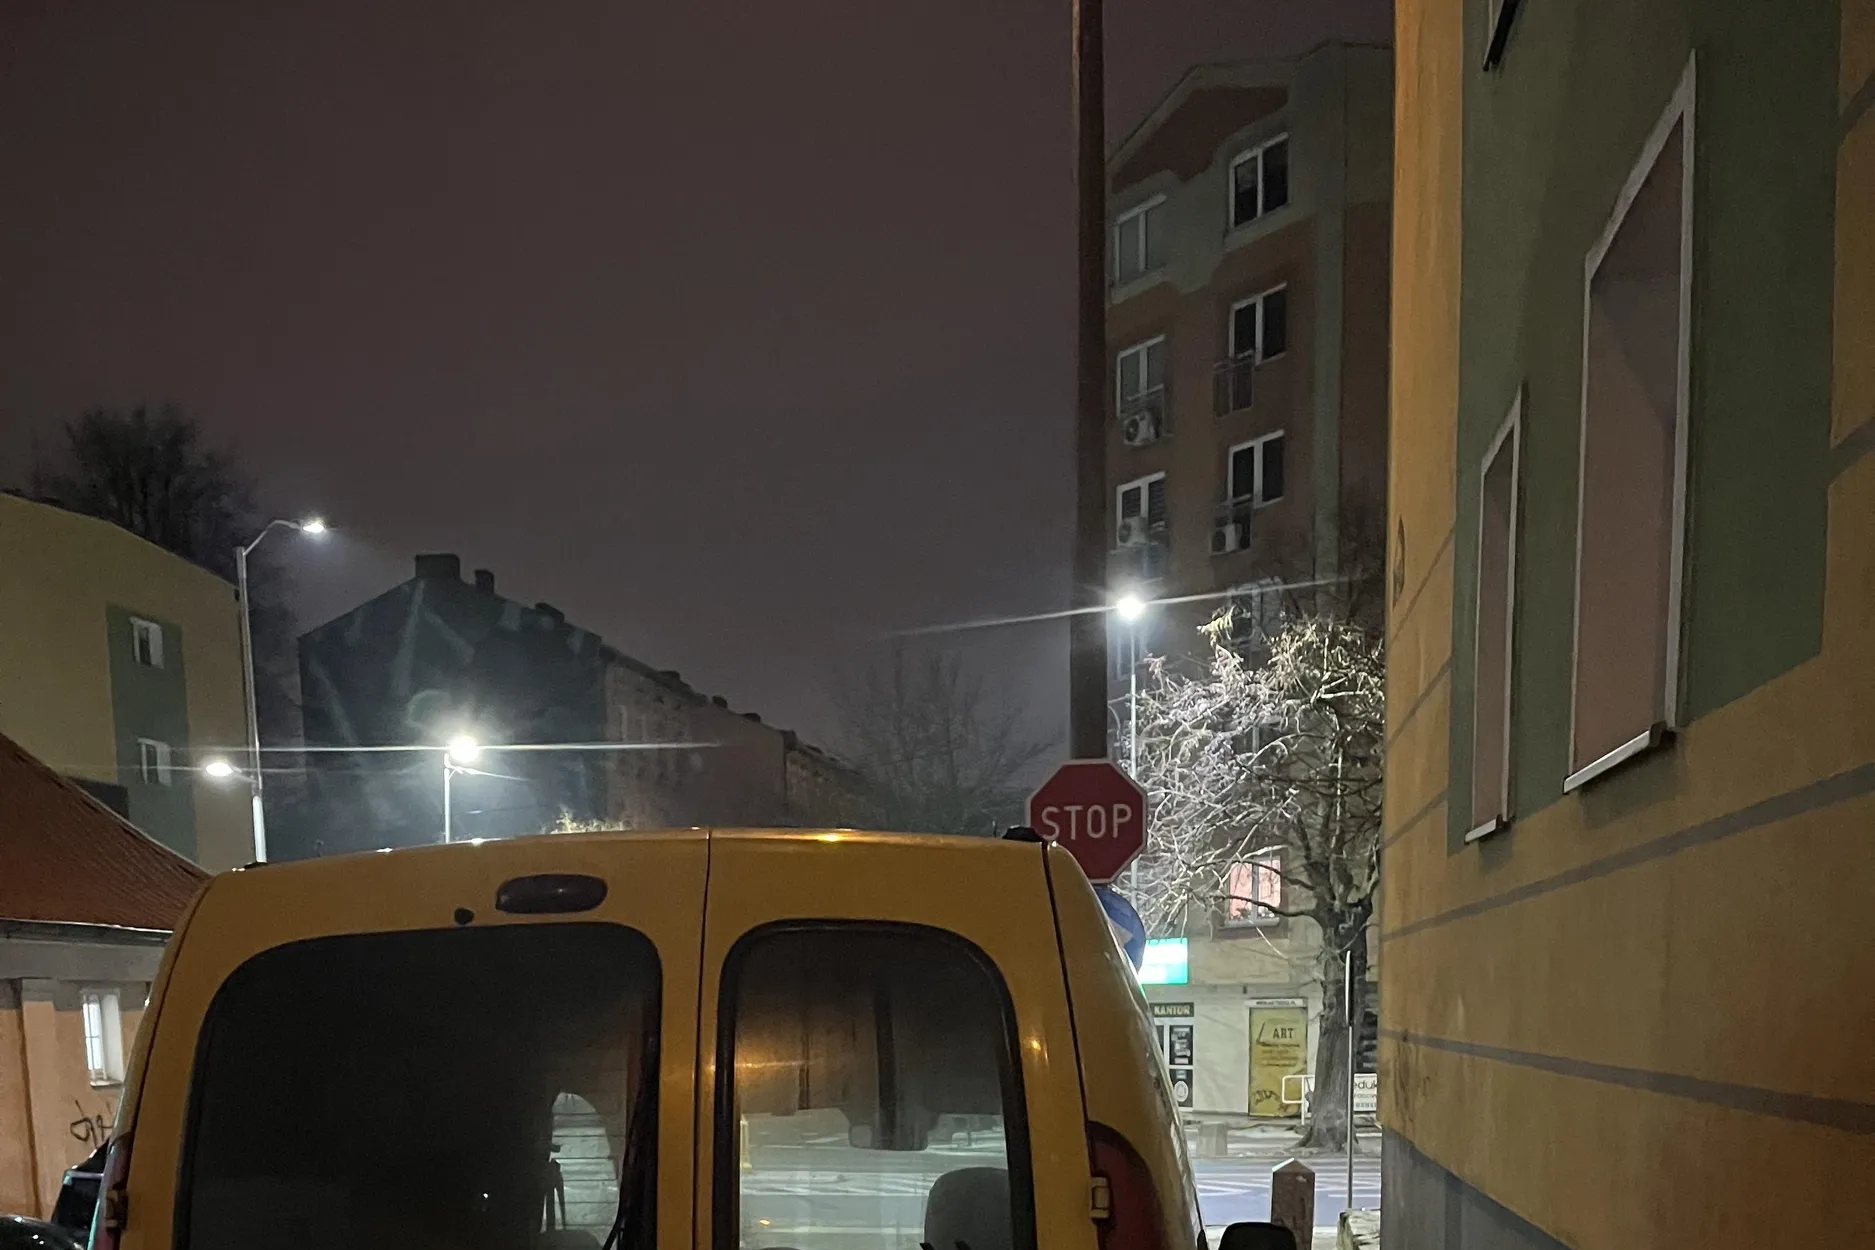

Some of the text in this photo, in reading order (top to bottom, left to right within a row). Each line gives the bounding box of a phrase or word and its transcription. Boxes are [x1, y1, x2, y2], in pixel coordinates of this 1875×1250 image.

[1041, 803, 1132, 841] STOP
[1154, 1005, 1190, 1015] KANTOR
[1273, 1027, 1293, 1039] ART
